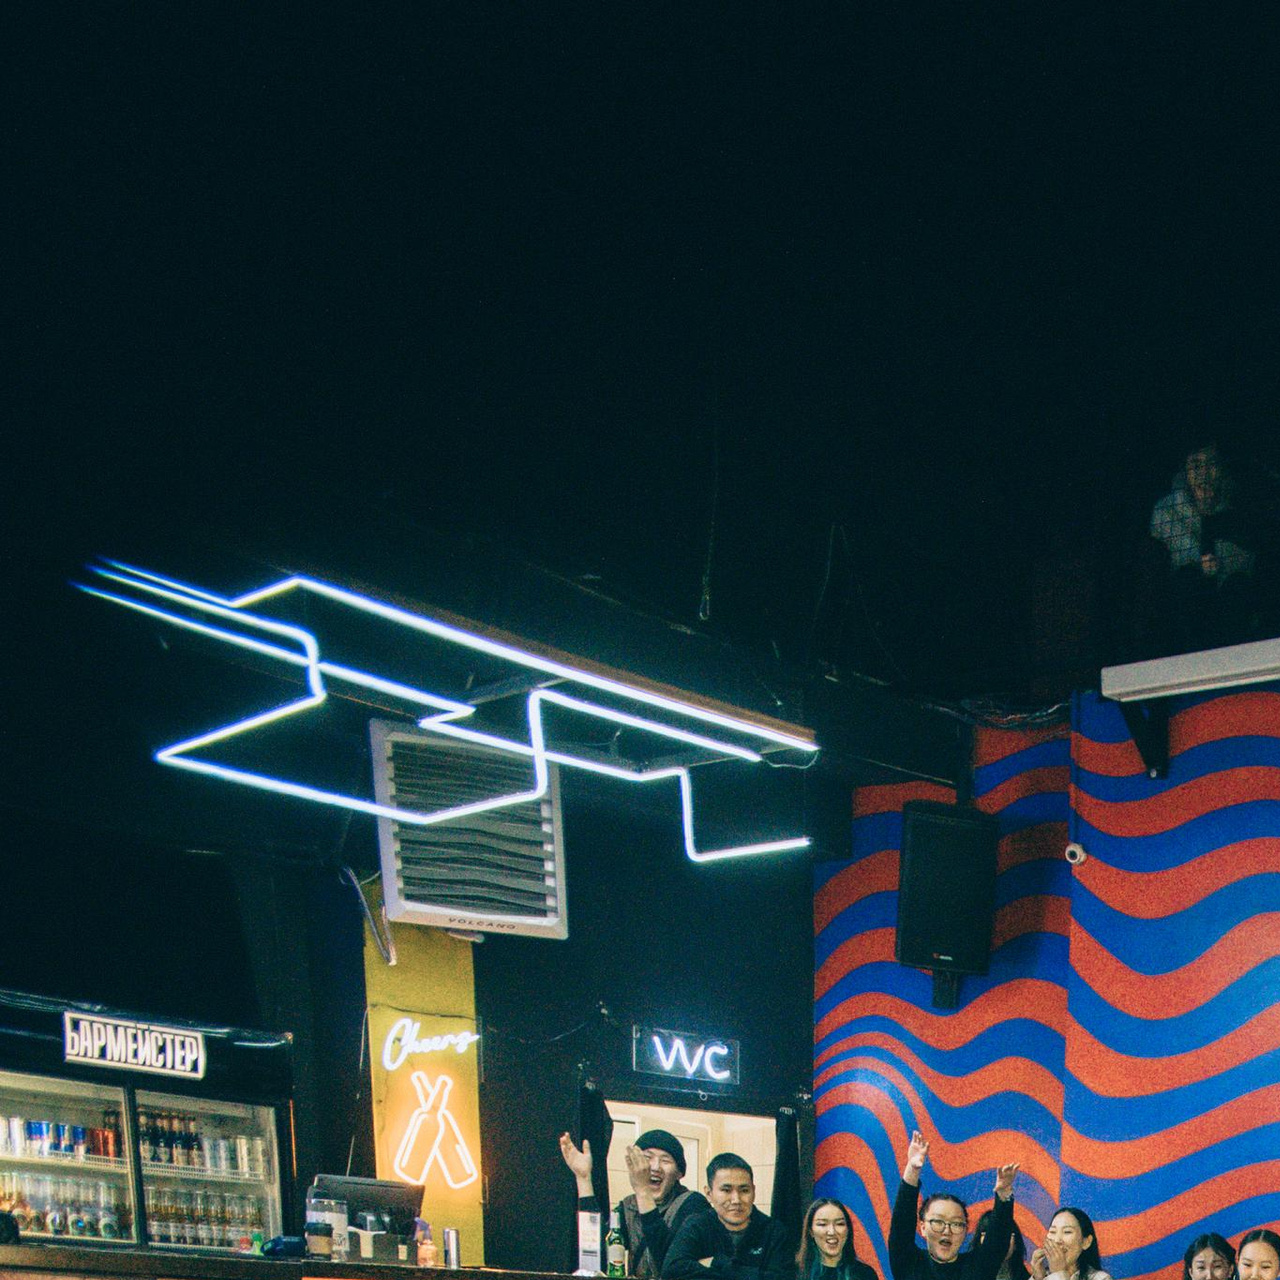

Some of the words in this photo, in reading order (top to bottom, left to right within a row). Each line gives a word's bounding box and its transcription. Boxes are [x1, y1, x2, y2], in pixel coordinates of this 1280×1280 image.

[448, 917, 517, 930] VOLCANO
[65, 1013, 200, 1073] БАРМЕЙСТЕР
[651, 1034, 731, 1080] WC
